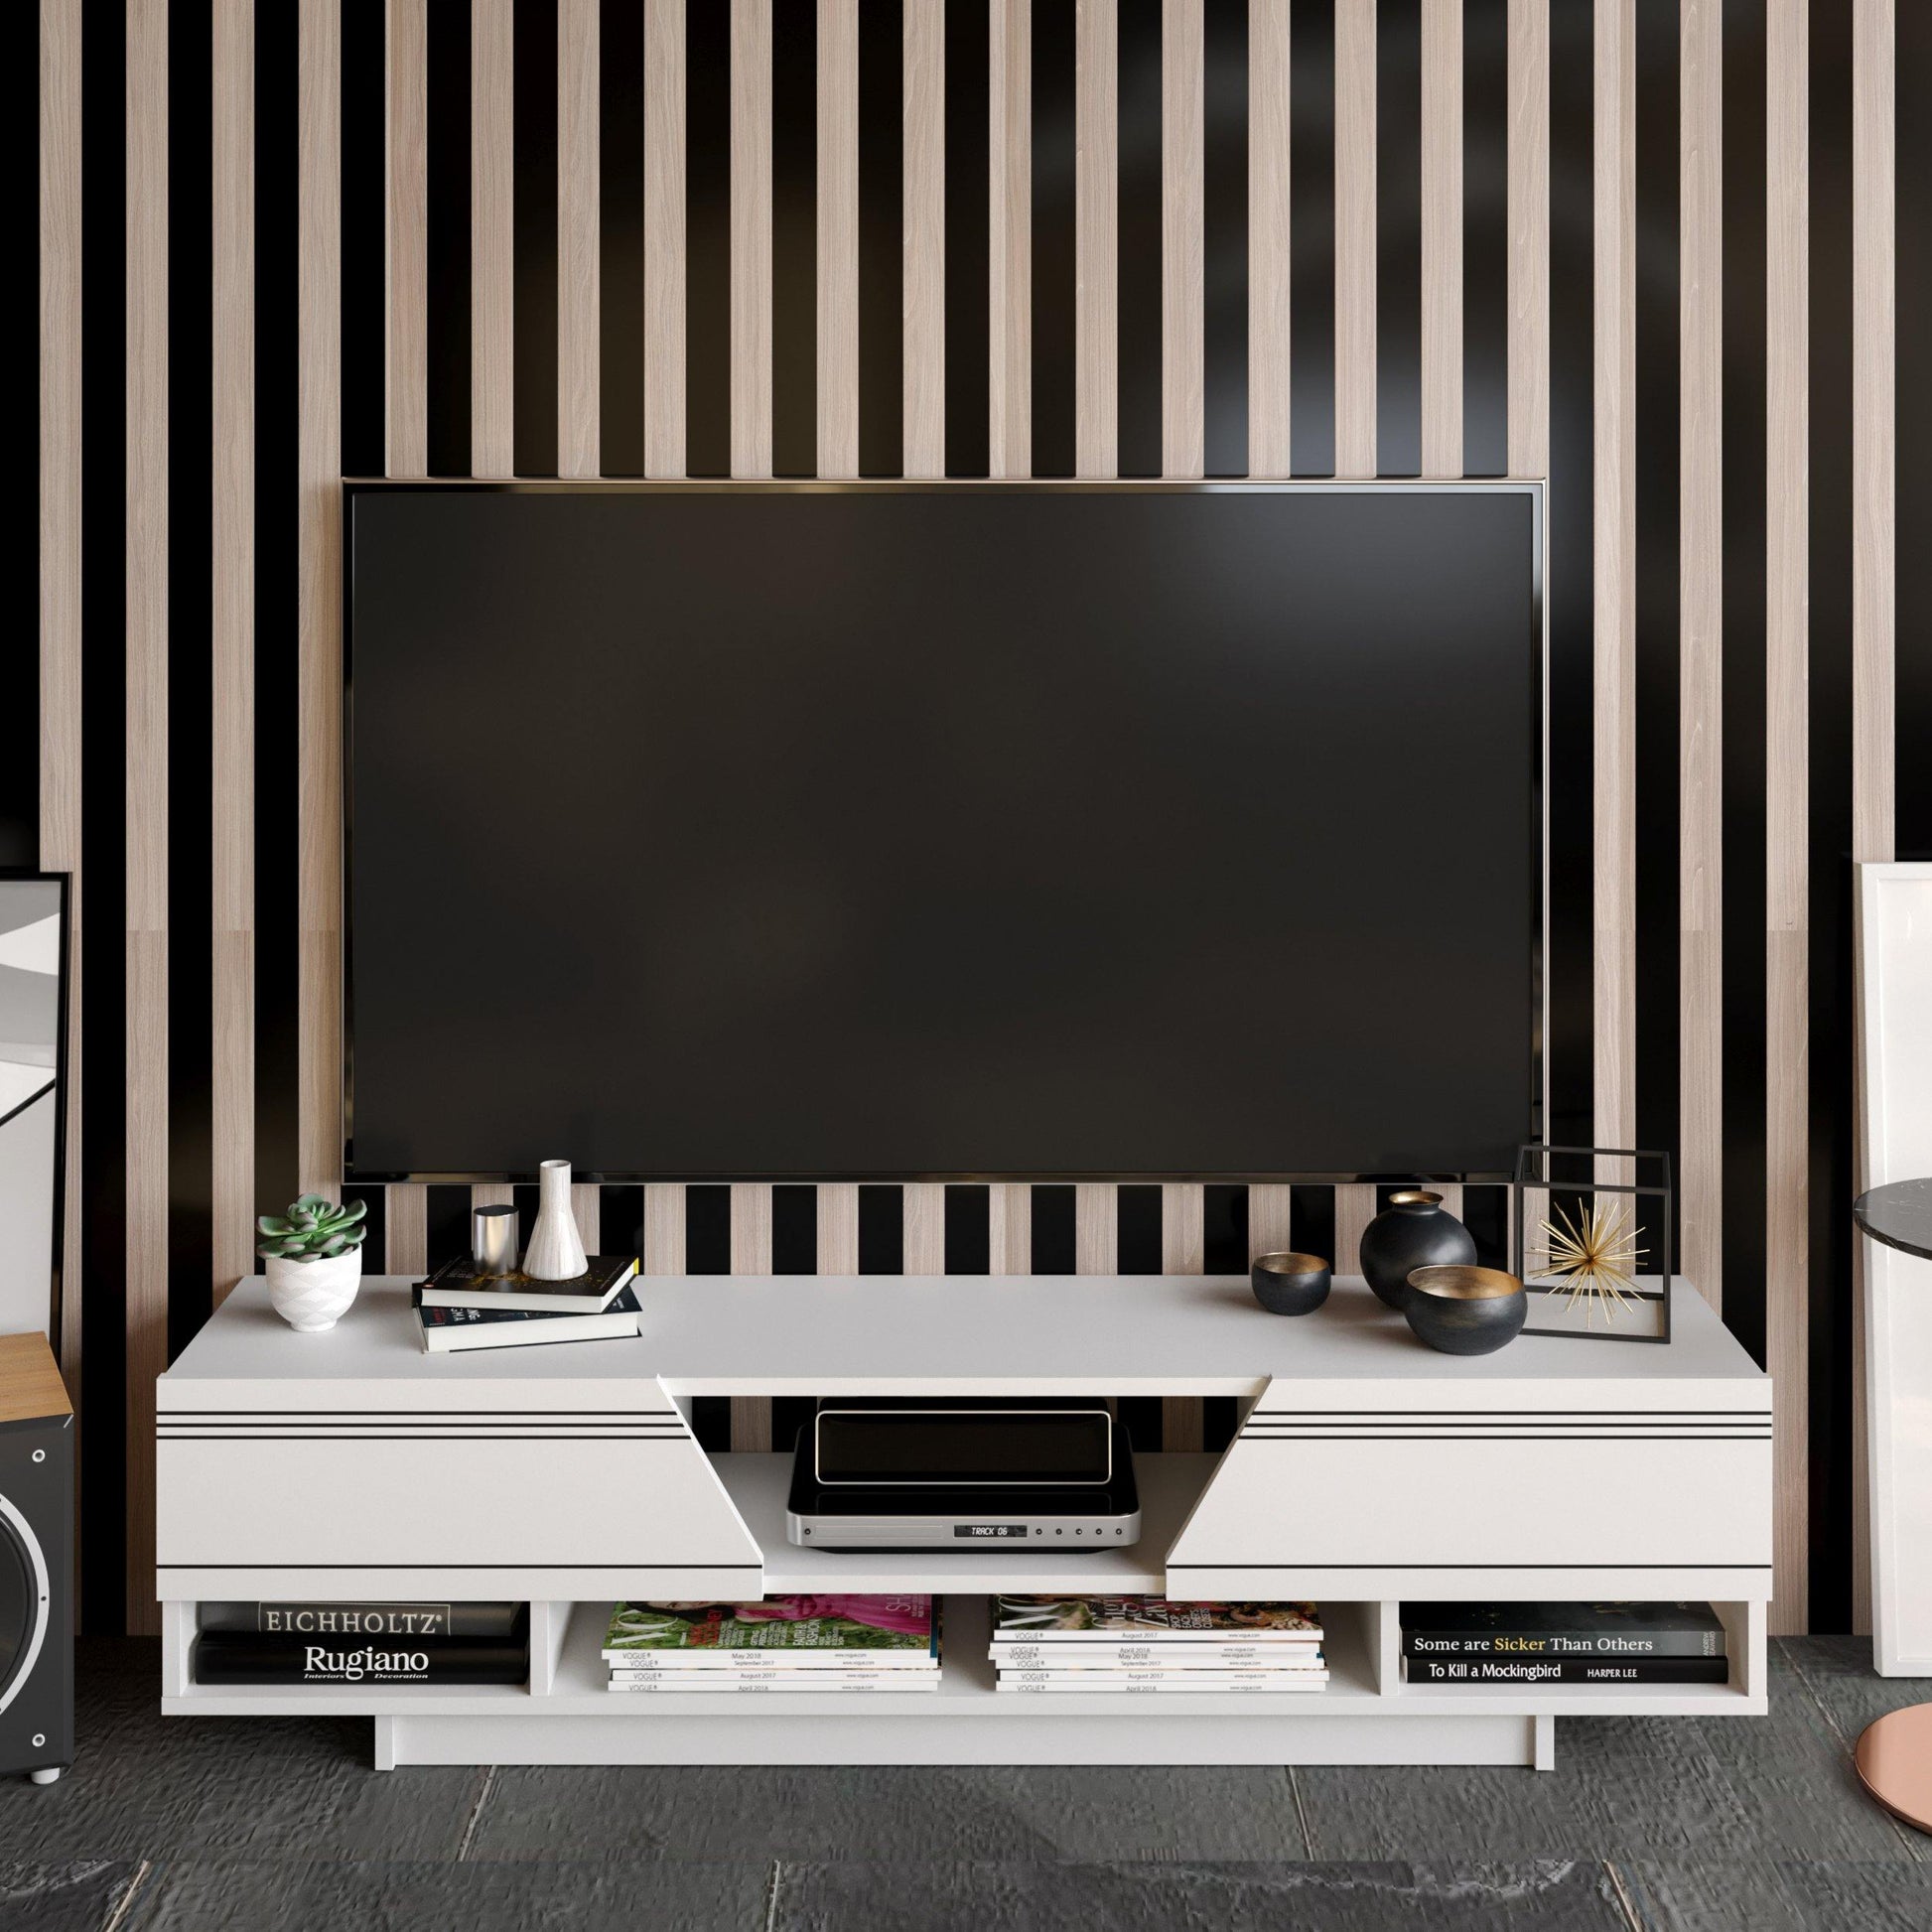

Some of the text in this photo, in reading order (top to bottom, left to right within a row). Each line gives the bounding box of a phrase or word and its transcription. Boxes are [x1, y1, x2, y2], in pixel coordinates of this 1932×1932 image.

[1414, 1637, 1653, 1651] Some are Sicker Than Others
[304, 1646, 429, 1681] Rugiano
[1429, 1664, 1637, 1681] To Kill a Mockingbird HARPER LEE
